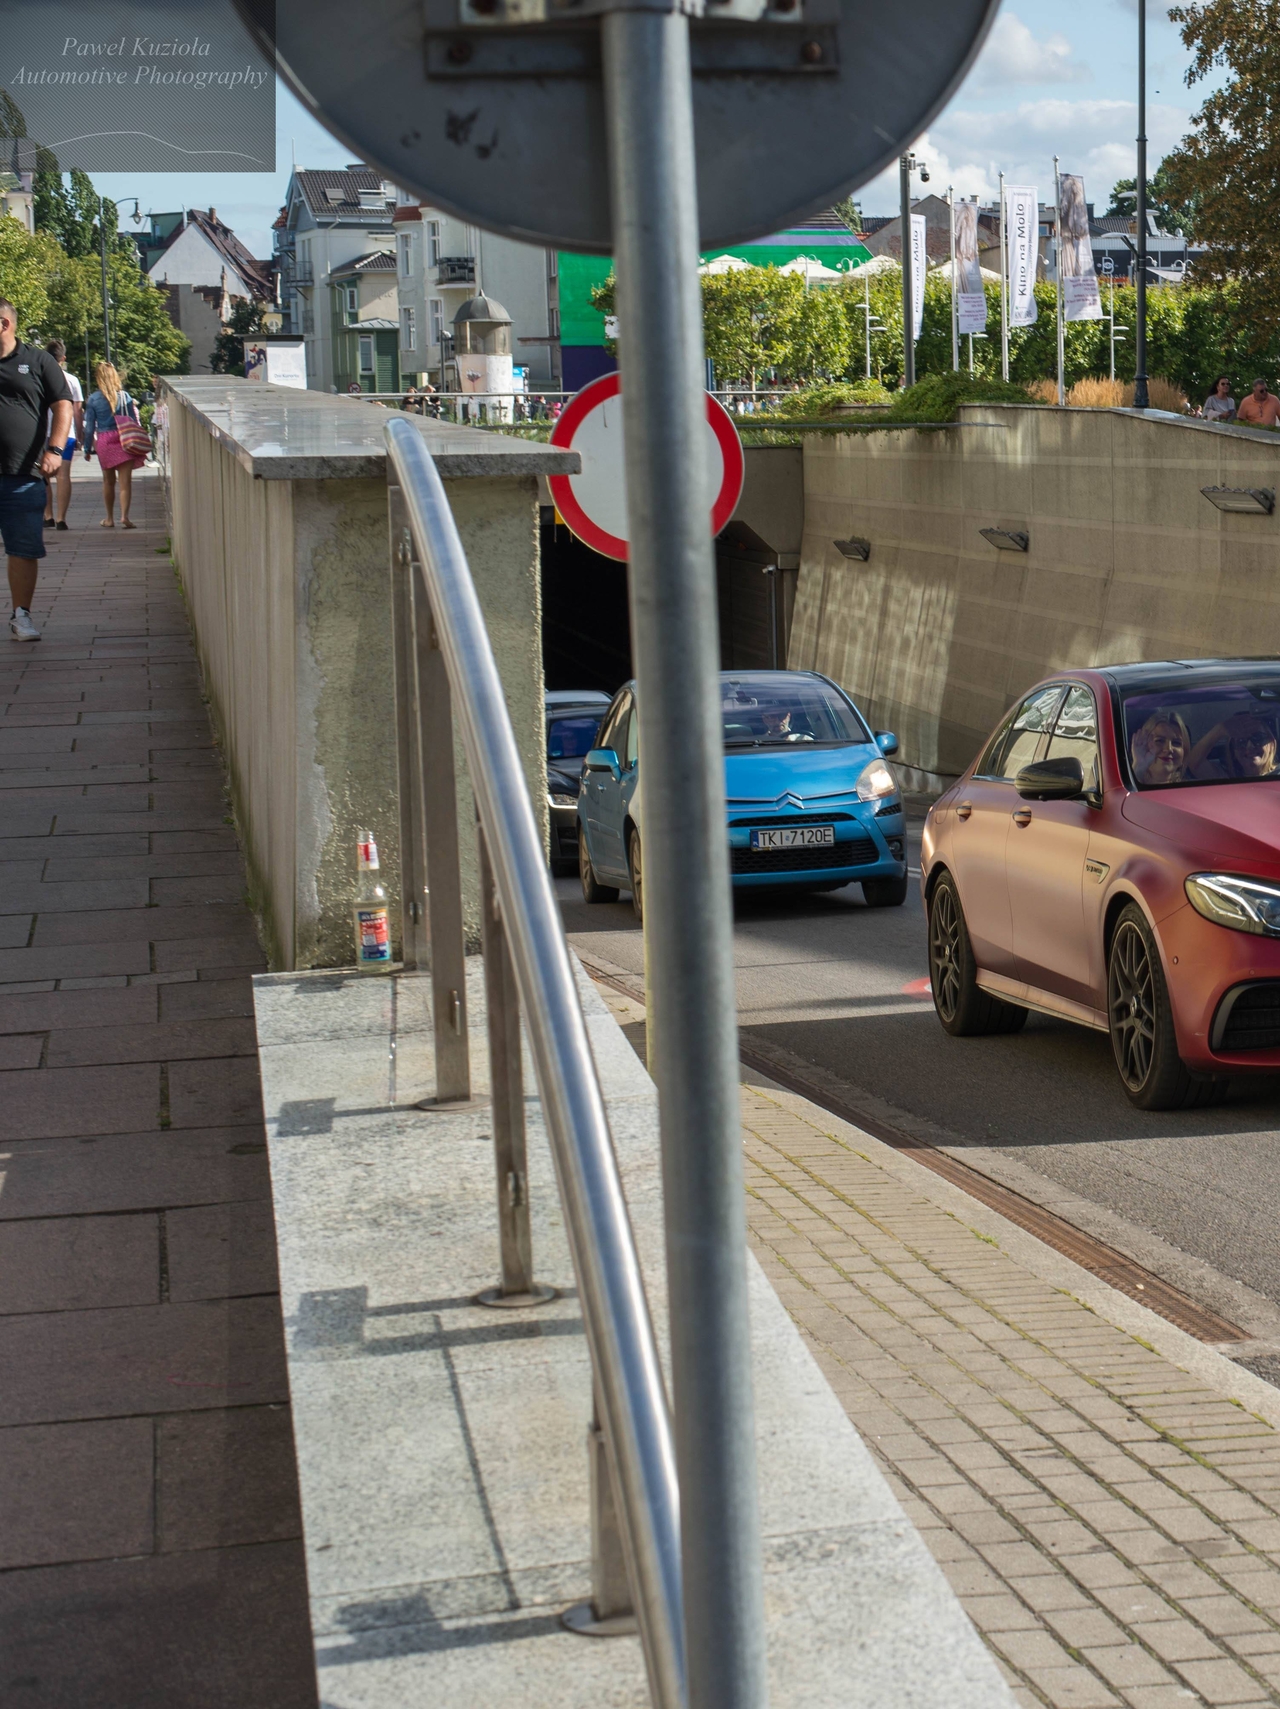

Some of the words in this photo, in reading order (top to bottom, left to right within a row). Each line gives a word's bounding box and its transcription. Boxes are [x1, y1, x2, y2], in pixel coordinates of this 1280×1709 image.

[1016, 203, 1026, 239] Molo
[1019, 244, 1026, 260] na
[1018, 266, 1027, 296] Kino
[759, 831, 783, 847] TKI
[790, 828, 832, 844] 7120E
